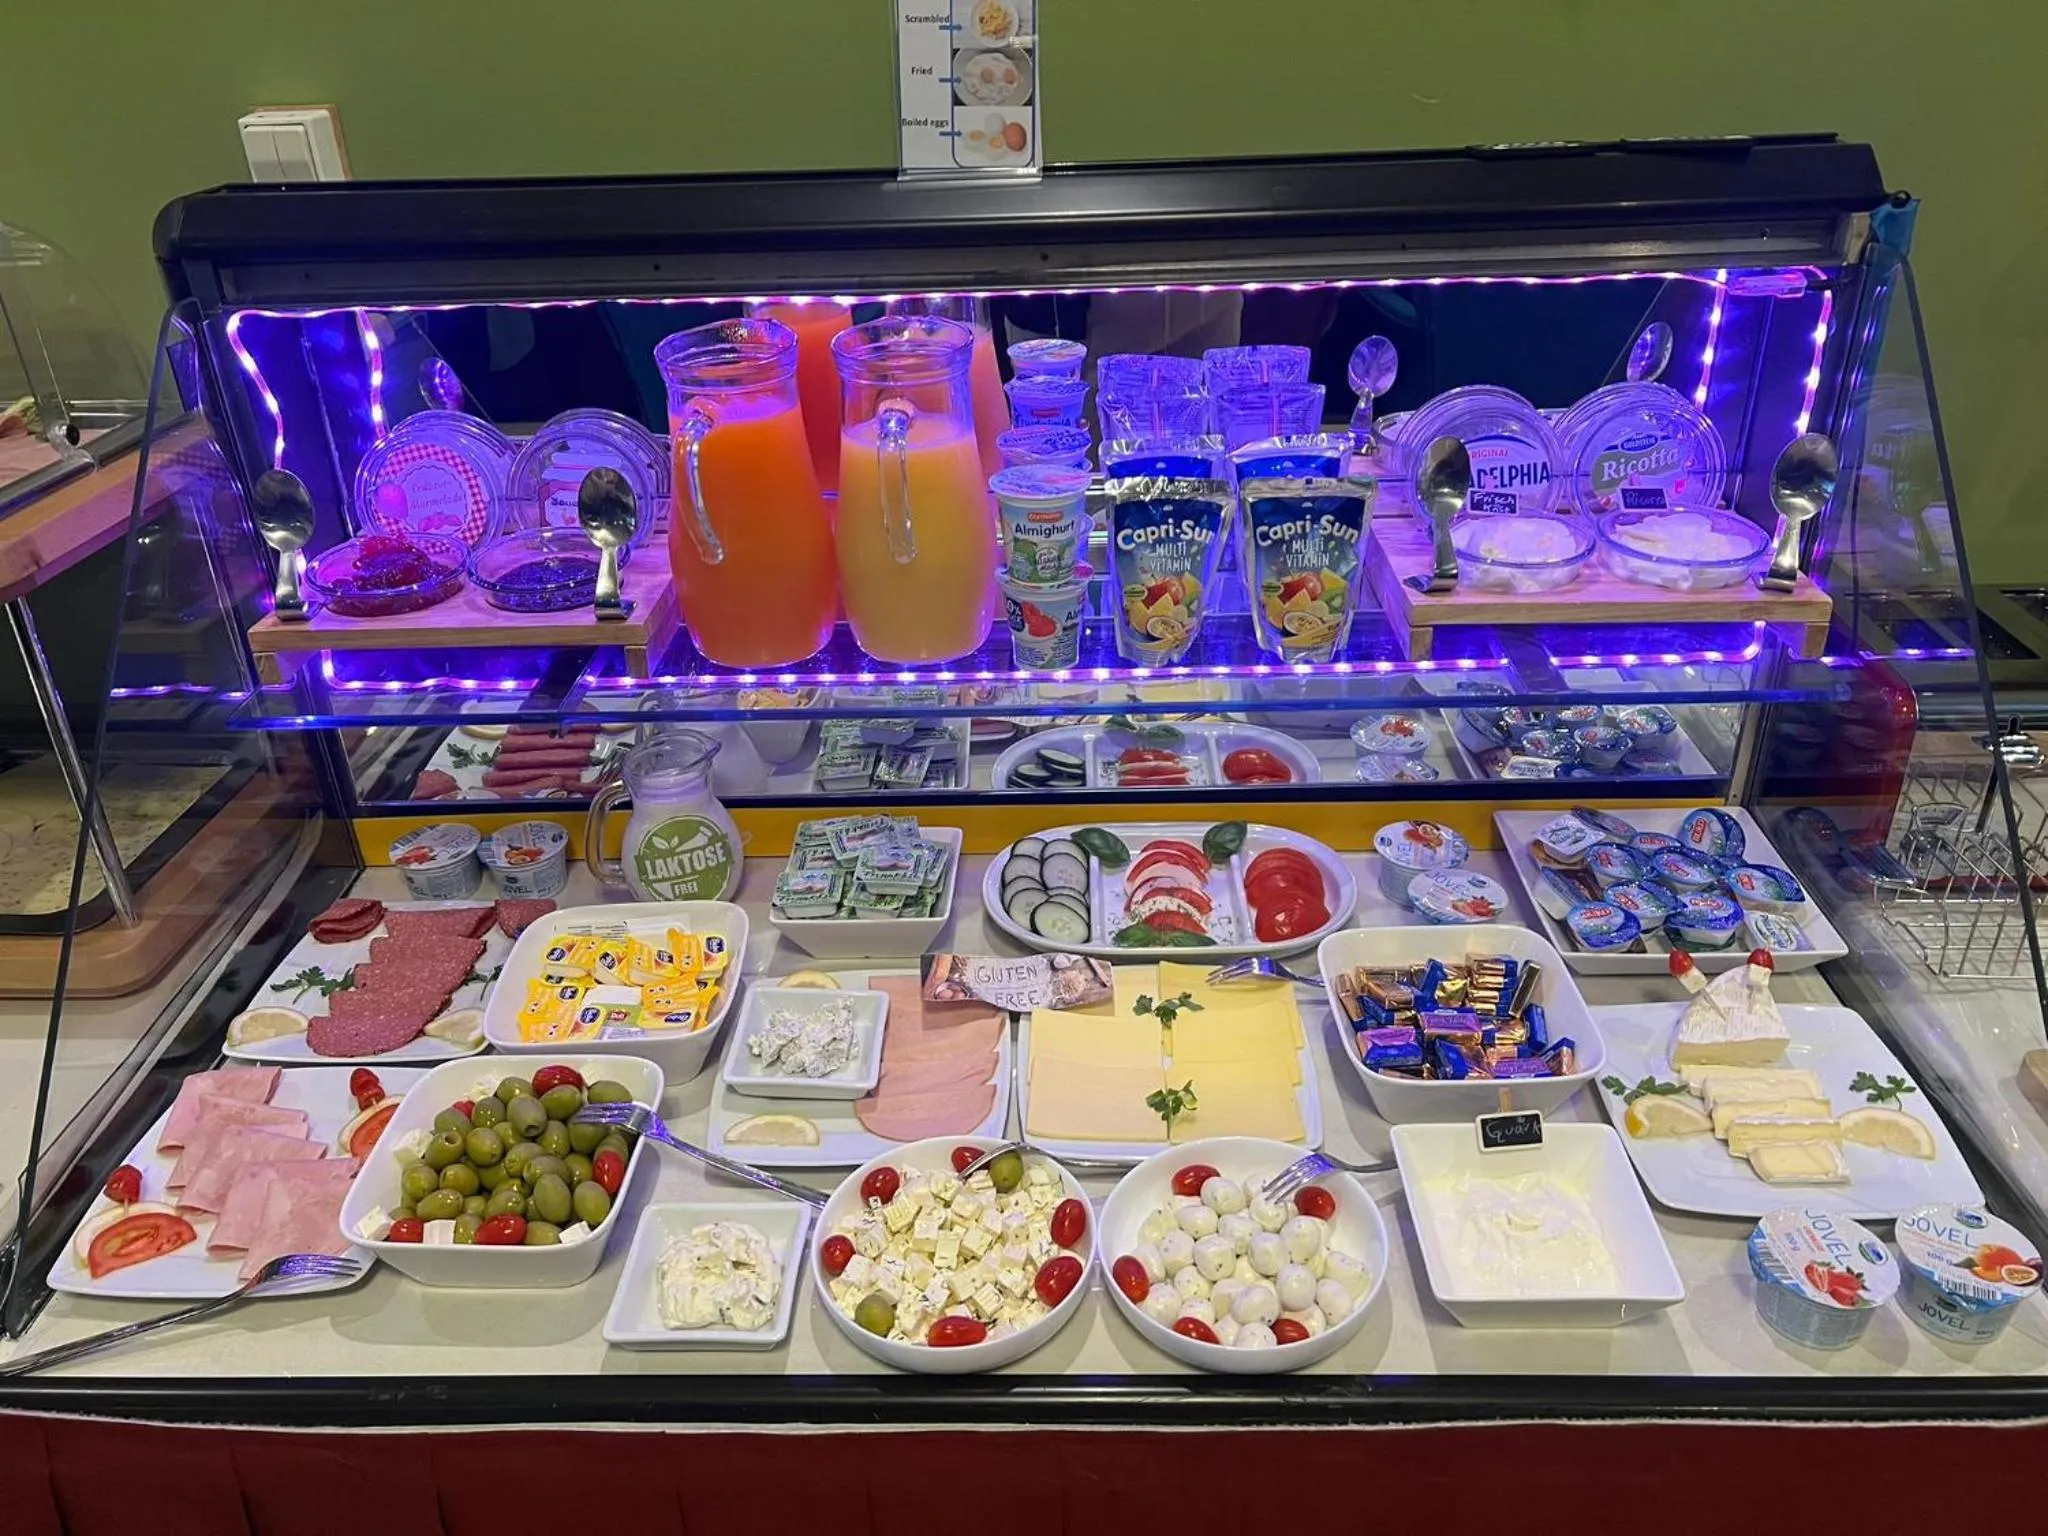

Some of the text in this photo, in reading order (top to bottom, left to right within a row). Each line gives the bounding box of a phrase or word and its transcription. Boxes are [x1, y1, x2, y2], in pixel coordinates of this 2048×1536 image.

[905, 15, 950, 23] Scrambled
[911, 67, 933, 75] Fried
[902, 118, 949, 128] Boiled eggs
[1470, 448, 1508, 459] RIGINAL
[1602, 447, 1679, 481] Ricotta
[1469, 461, 1550, 489] DELPHIA
[1015, 519, 1076, 539] Almighurt
[1256, 514, 1360, 548] Capri-Sun
[645, 842, 727, 880] LAKTOSE
[675, 881, 699, 896] FREI
[974, 965, 1038, 984] GLUTEN
[995, 990, 1040, 1008] FREE
[1805, 1208, 1852, 1266] JOVEL
[1903, 1216, 1979, 1250] JOVEL
[1917, 1301, 1971, 1332] JOVEL
